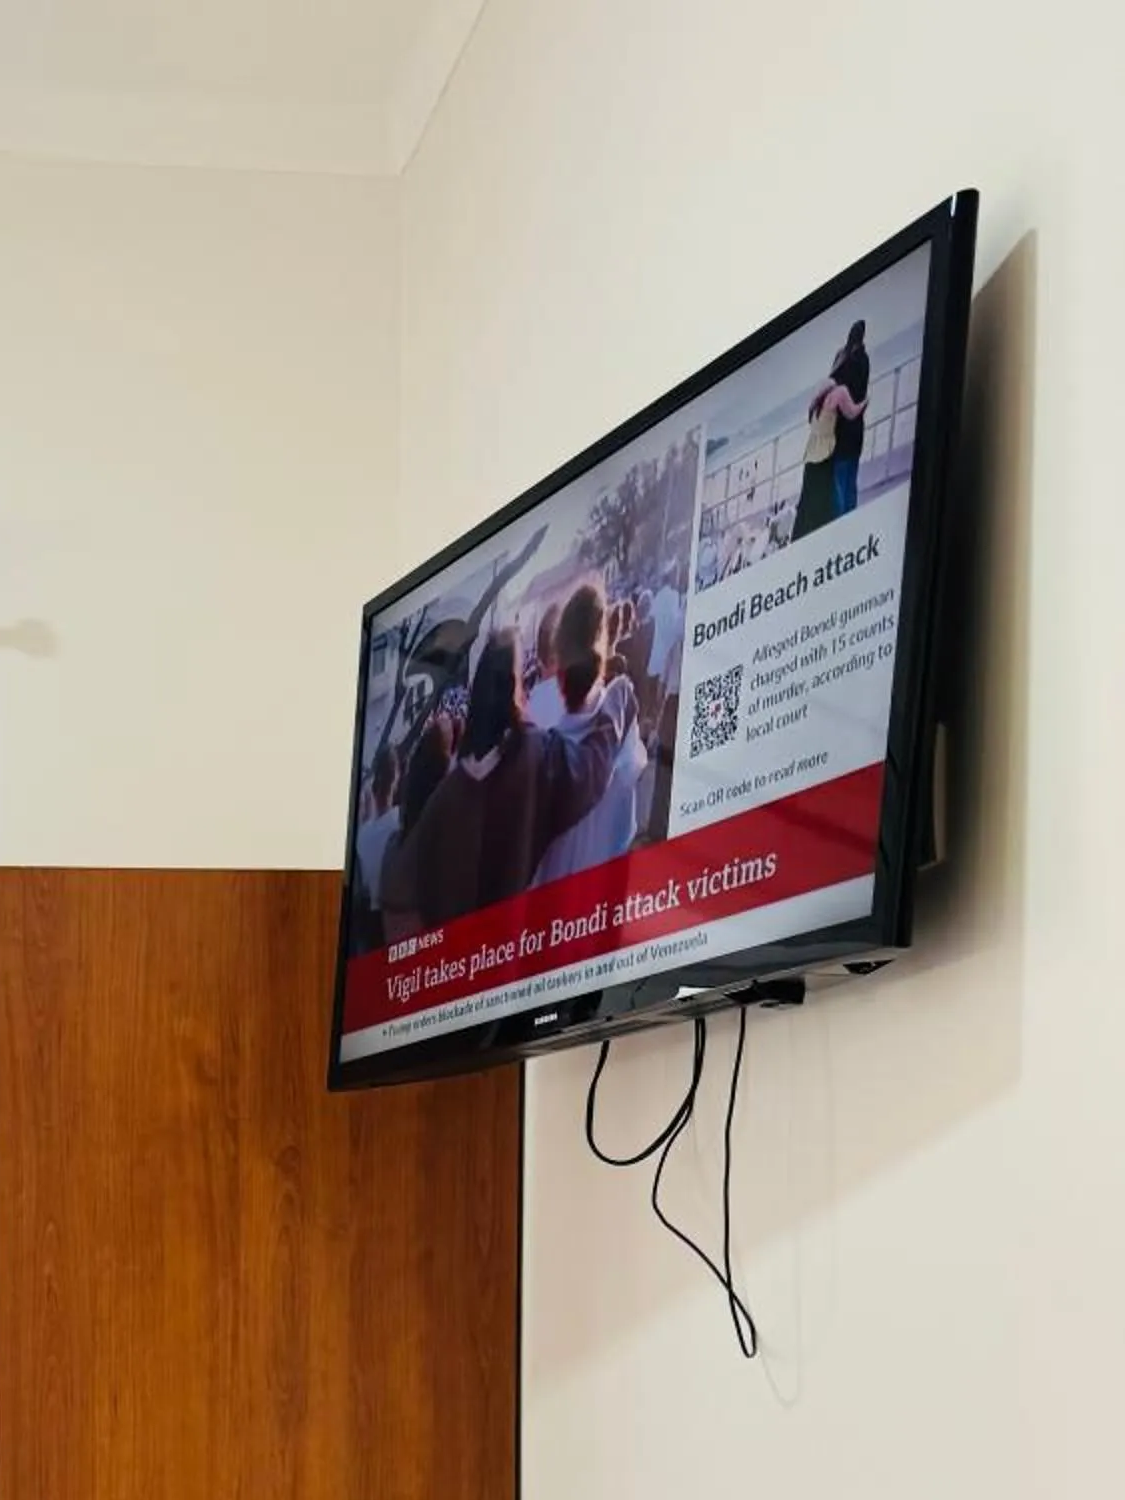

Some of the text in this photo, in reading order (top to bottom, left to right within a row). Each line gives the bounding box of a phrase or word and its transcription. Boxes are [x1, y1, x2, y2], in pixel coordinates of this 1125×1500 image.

[693, 533, 880, 648] Bondi Beach attack
[753, 588, 894, 664] Alleged Bondi gunman
[747, 643, 893, 716] of murder, according to
[750, 614, 894, 690] charged with 15 counts
[746, 703, 809, 742] local court
[679, 751, 829, 817] Scan QR code to read more
[386, 852, 778, 1004] Vigil takes place for Bondi attack victims
[418, 929, 444, 950] NEWS
[595, 958, 615, 977] and
[616, 953, 635, 972] out
[636, 945, 649, 964] of
[650, 930, 708, 962] Venezuela
